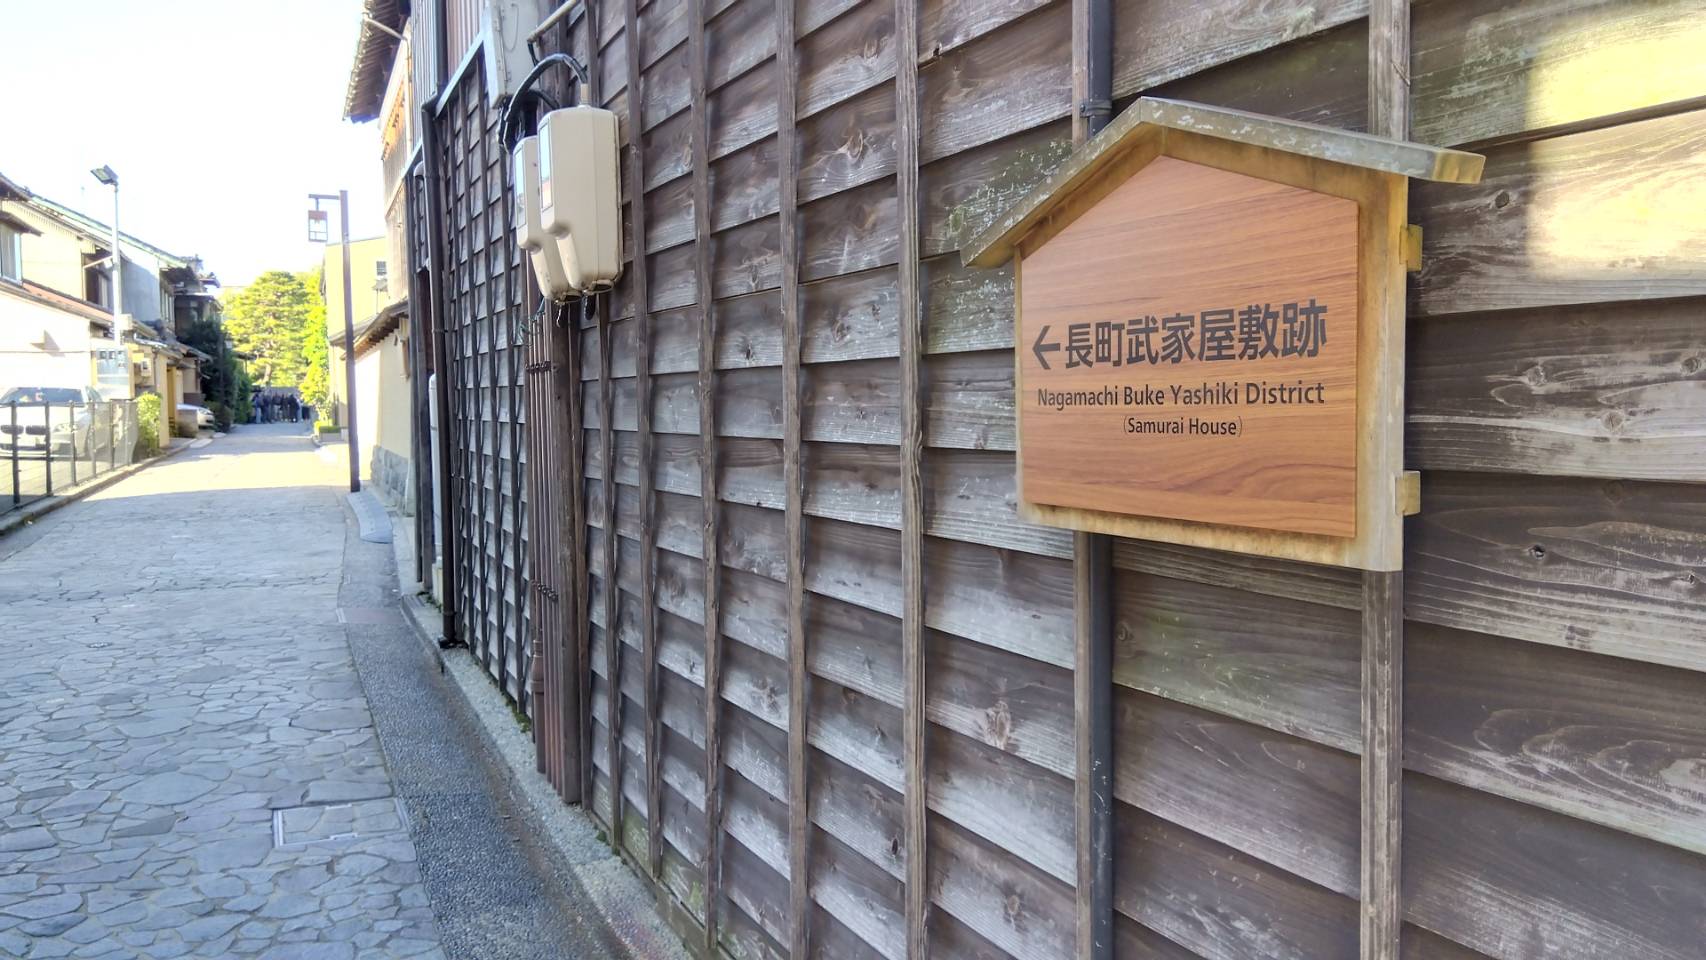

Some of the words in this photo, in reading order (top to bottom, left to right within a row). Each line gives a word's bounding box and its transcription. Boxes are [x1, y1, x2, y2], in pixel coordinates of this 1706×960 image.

[1065, 299, 1328, 369] 長町武家屋敷跡
[1038, 386, 1118, 411] Nagamachi
[1123, 384, 1165, 405] Buke
[1170, 382, 1238, 405] Yashiki
[1245, 380, 1325, 404] District
[1123, 415, 1184, 436] (Samurai
[1189, 415, 1243, 437] House)
